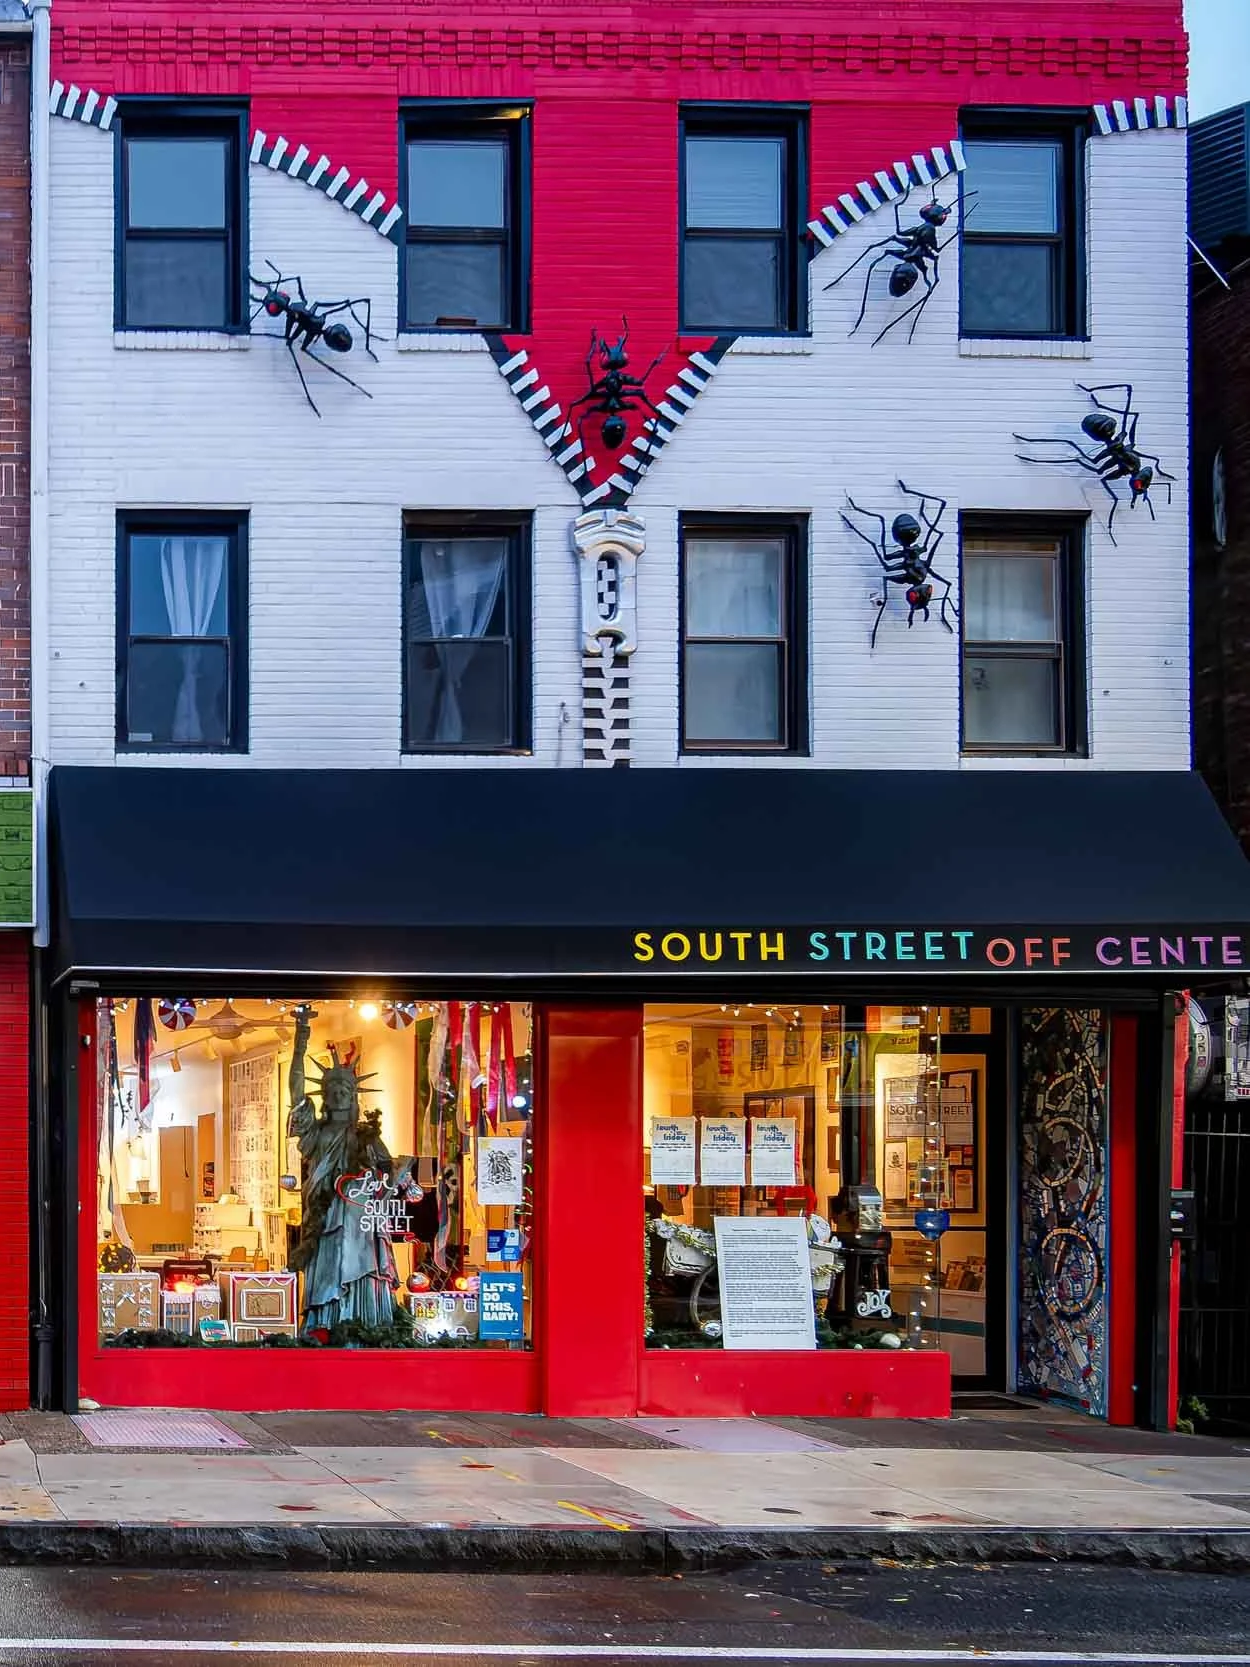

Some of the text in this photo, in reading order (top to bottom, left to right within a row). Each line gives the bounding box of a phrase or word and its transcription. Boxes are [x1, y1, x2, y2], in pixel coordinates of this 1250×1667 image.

[634, 932, 785, 961] SOUTH
[809, 931, 974, 961] STREET
[986, 938, 1071, 967] OFF
[931, 1105, 970, 1115] SREET
[364, 1199, 407, 1216] SOUTH
[360, 1215, 414, 1233] STREET
[483, 1282, 516, 1292] LET'S
[483, 1292, 500, 1302] DO
[483, 1302, 514, 1312] THIS,
[857, 1289, 892, 1319] JOY
[483, 1312, 518, 1321] BABY!
